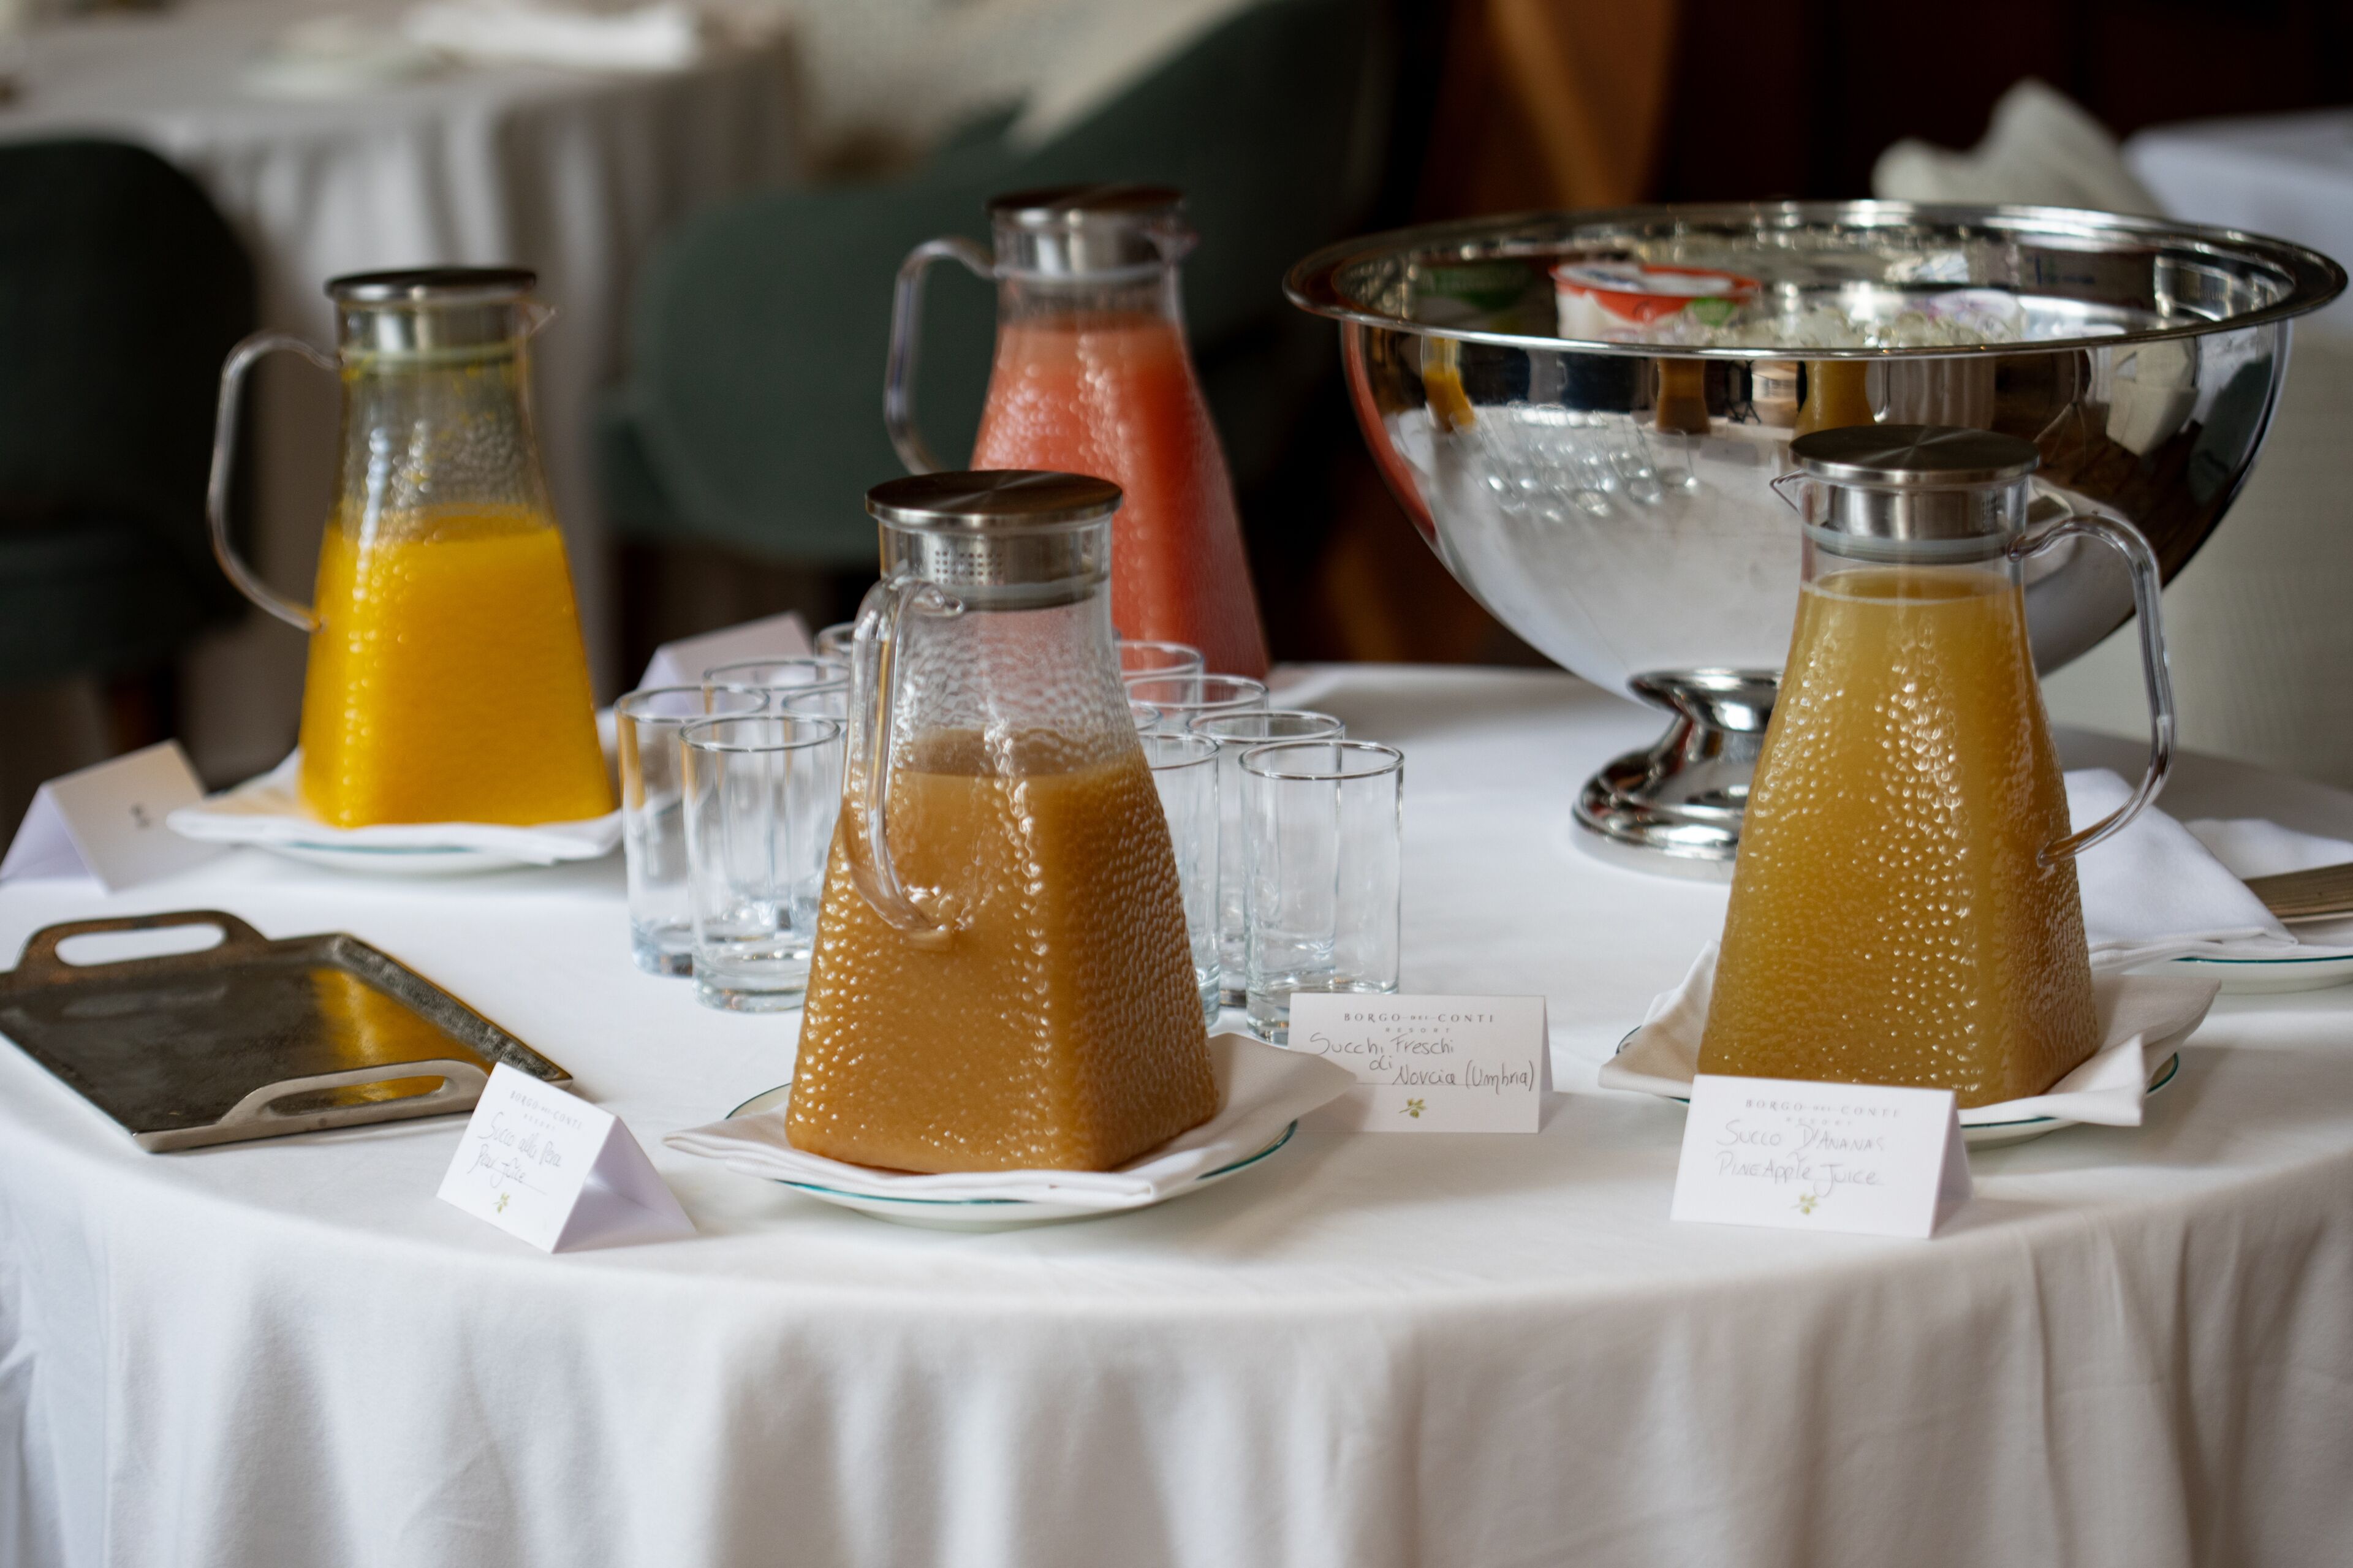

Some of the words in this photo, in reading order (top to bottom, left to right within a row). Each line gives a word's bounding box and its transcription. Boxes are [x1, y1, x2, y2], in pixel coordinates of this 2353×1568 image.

[1344, 1013, 1401, 1023] BORGO
[1438, 1013, 1495, 1023] CONTI
[1309, 1032, 1384, 1055] Succhi
[1390, 1034, 1454, 1055] Freschi
[1369, 1056, 1393, 1071] di
[1466, 1059, 1534, 1095] (Umbria)
[1745, 1098, 1803, 1112] BORGO
[1841, 1106, 1901, 1118] CONTI
